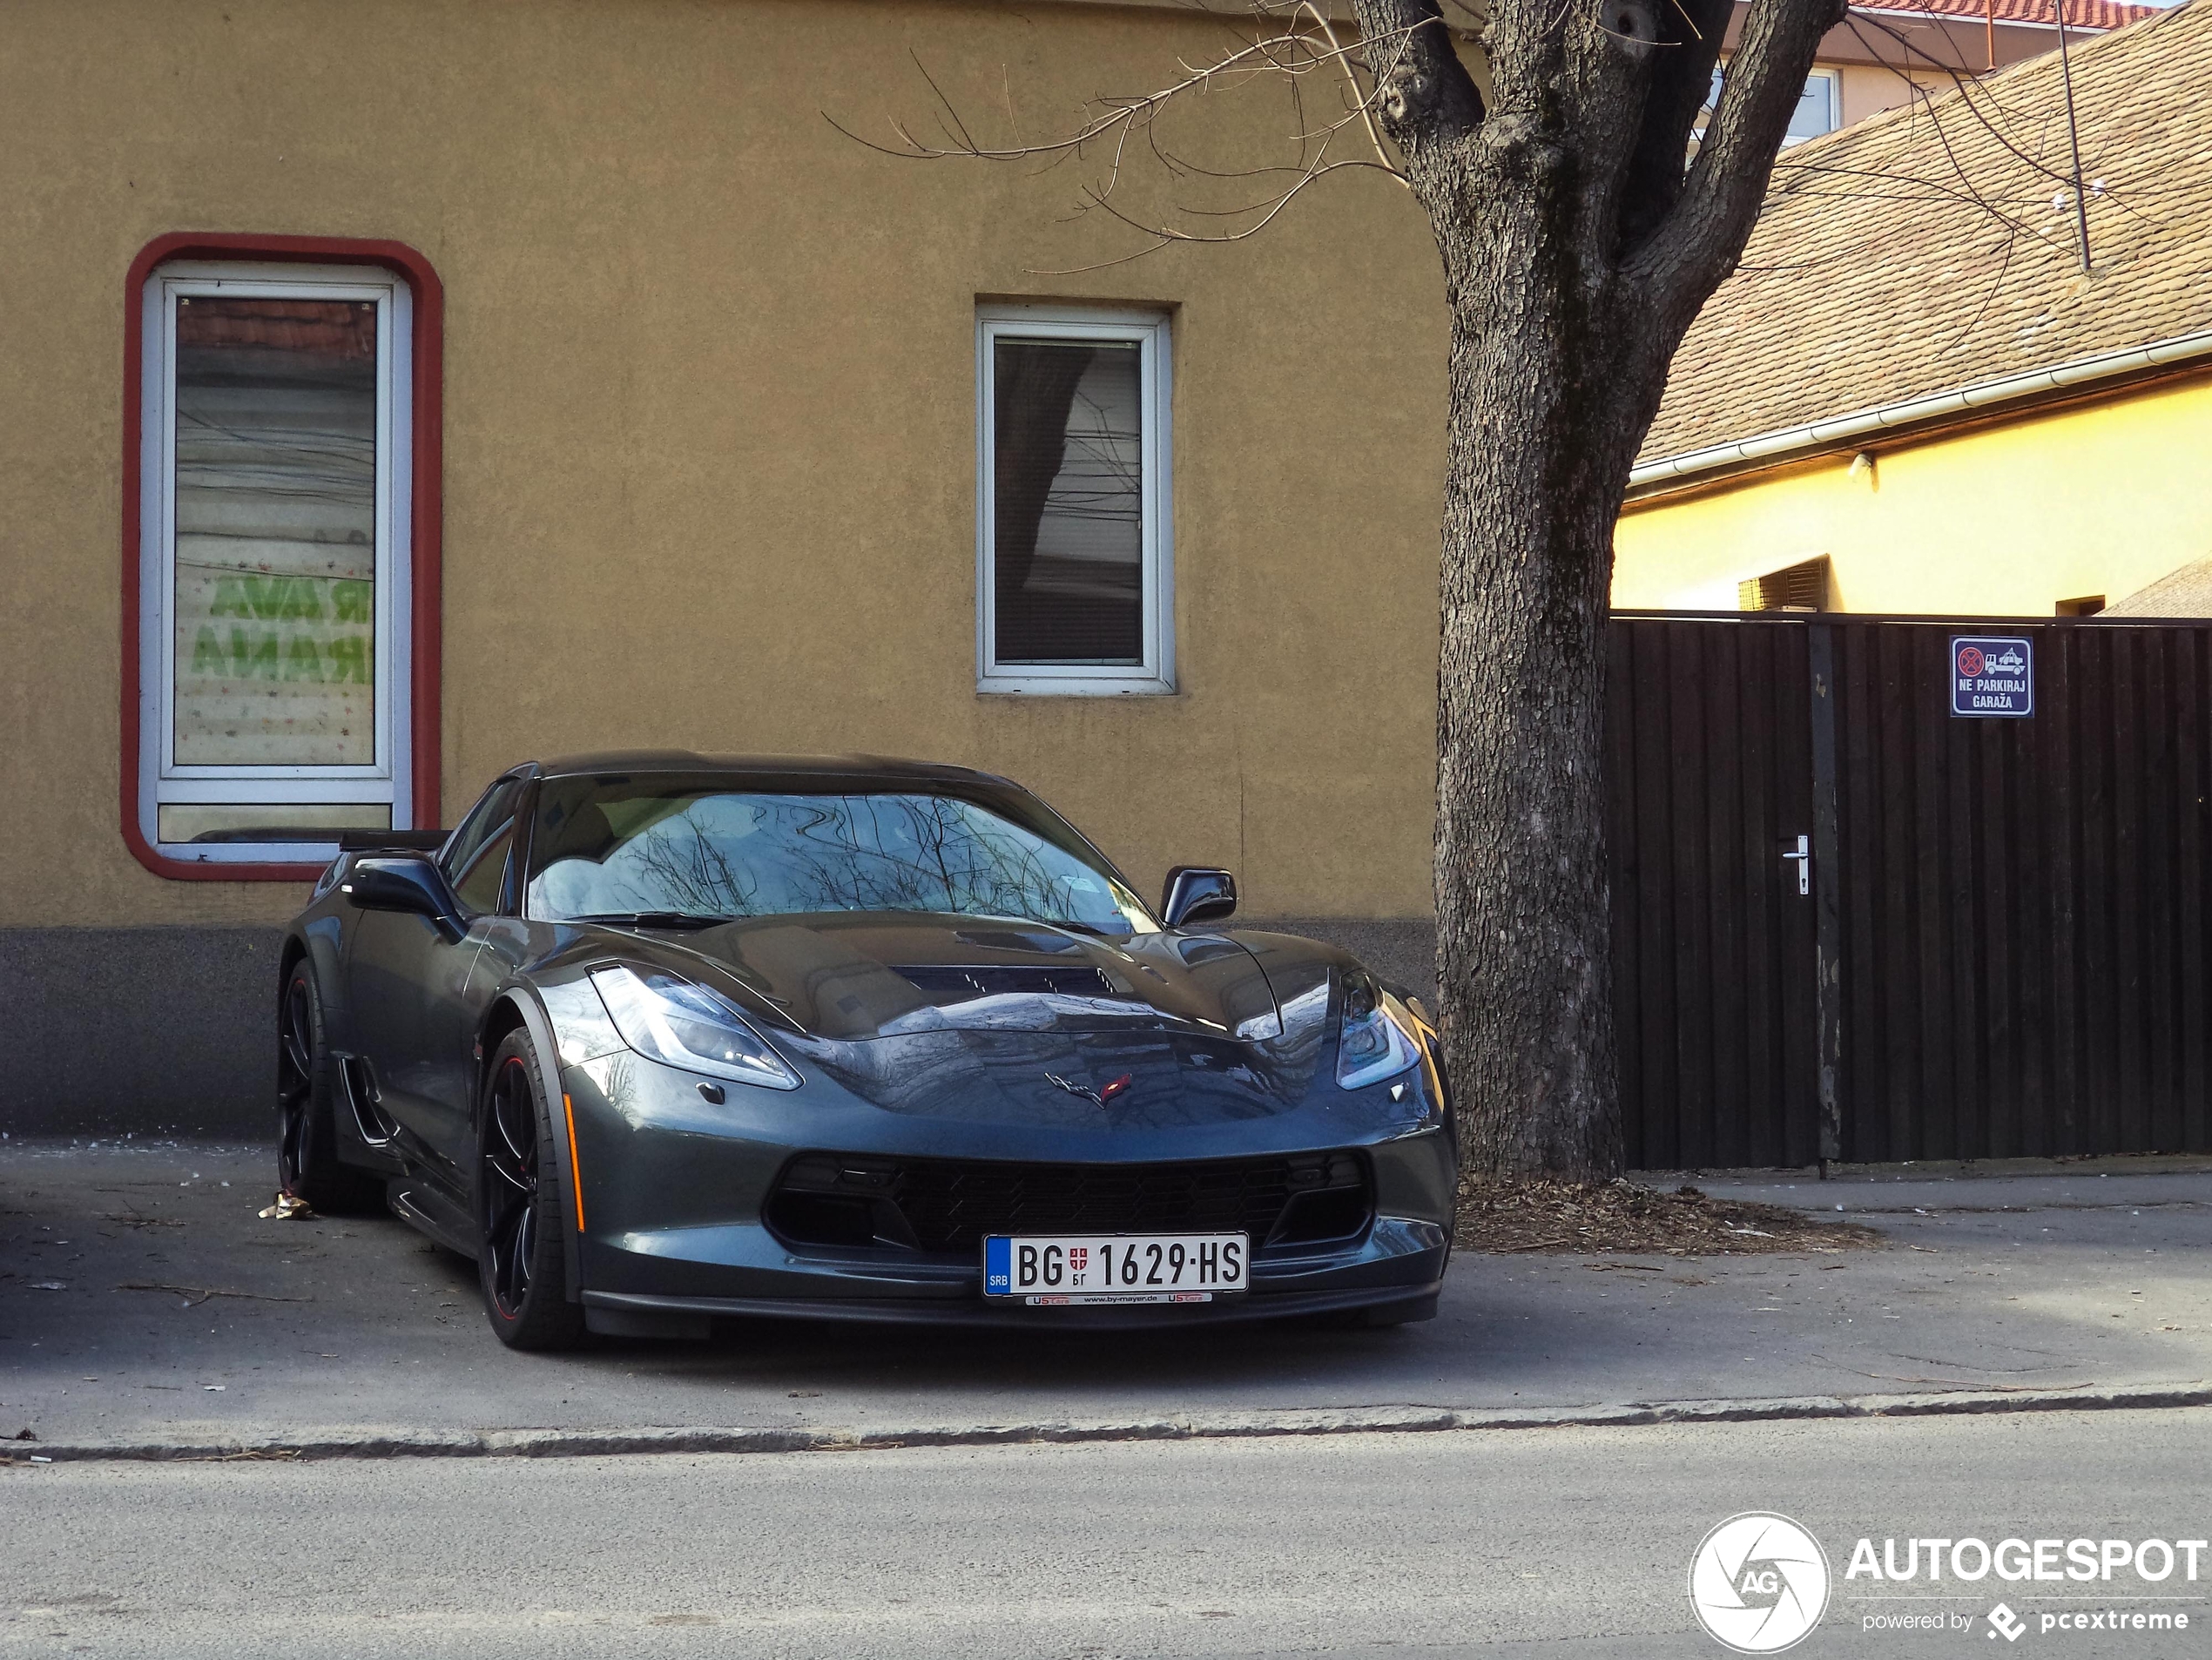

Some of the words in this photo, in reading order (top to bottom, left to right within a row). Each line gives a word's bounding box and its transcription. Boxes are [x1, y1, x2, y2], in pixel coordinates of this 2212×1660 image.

[1959, 678, 1973, 692] NE
[1977, 679, 2026, 692] PARKIRAJ
[1973, 692, 2013, 708] GARAŽA
[1018, 1245, 1062, 1286] BG
[989, 1275, 1008, 1286] SRB
[1083, 1295, 1157, 1305] www.by-mayer.de
